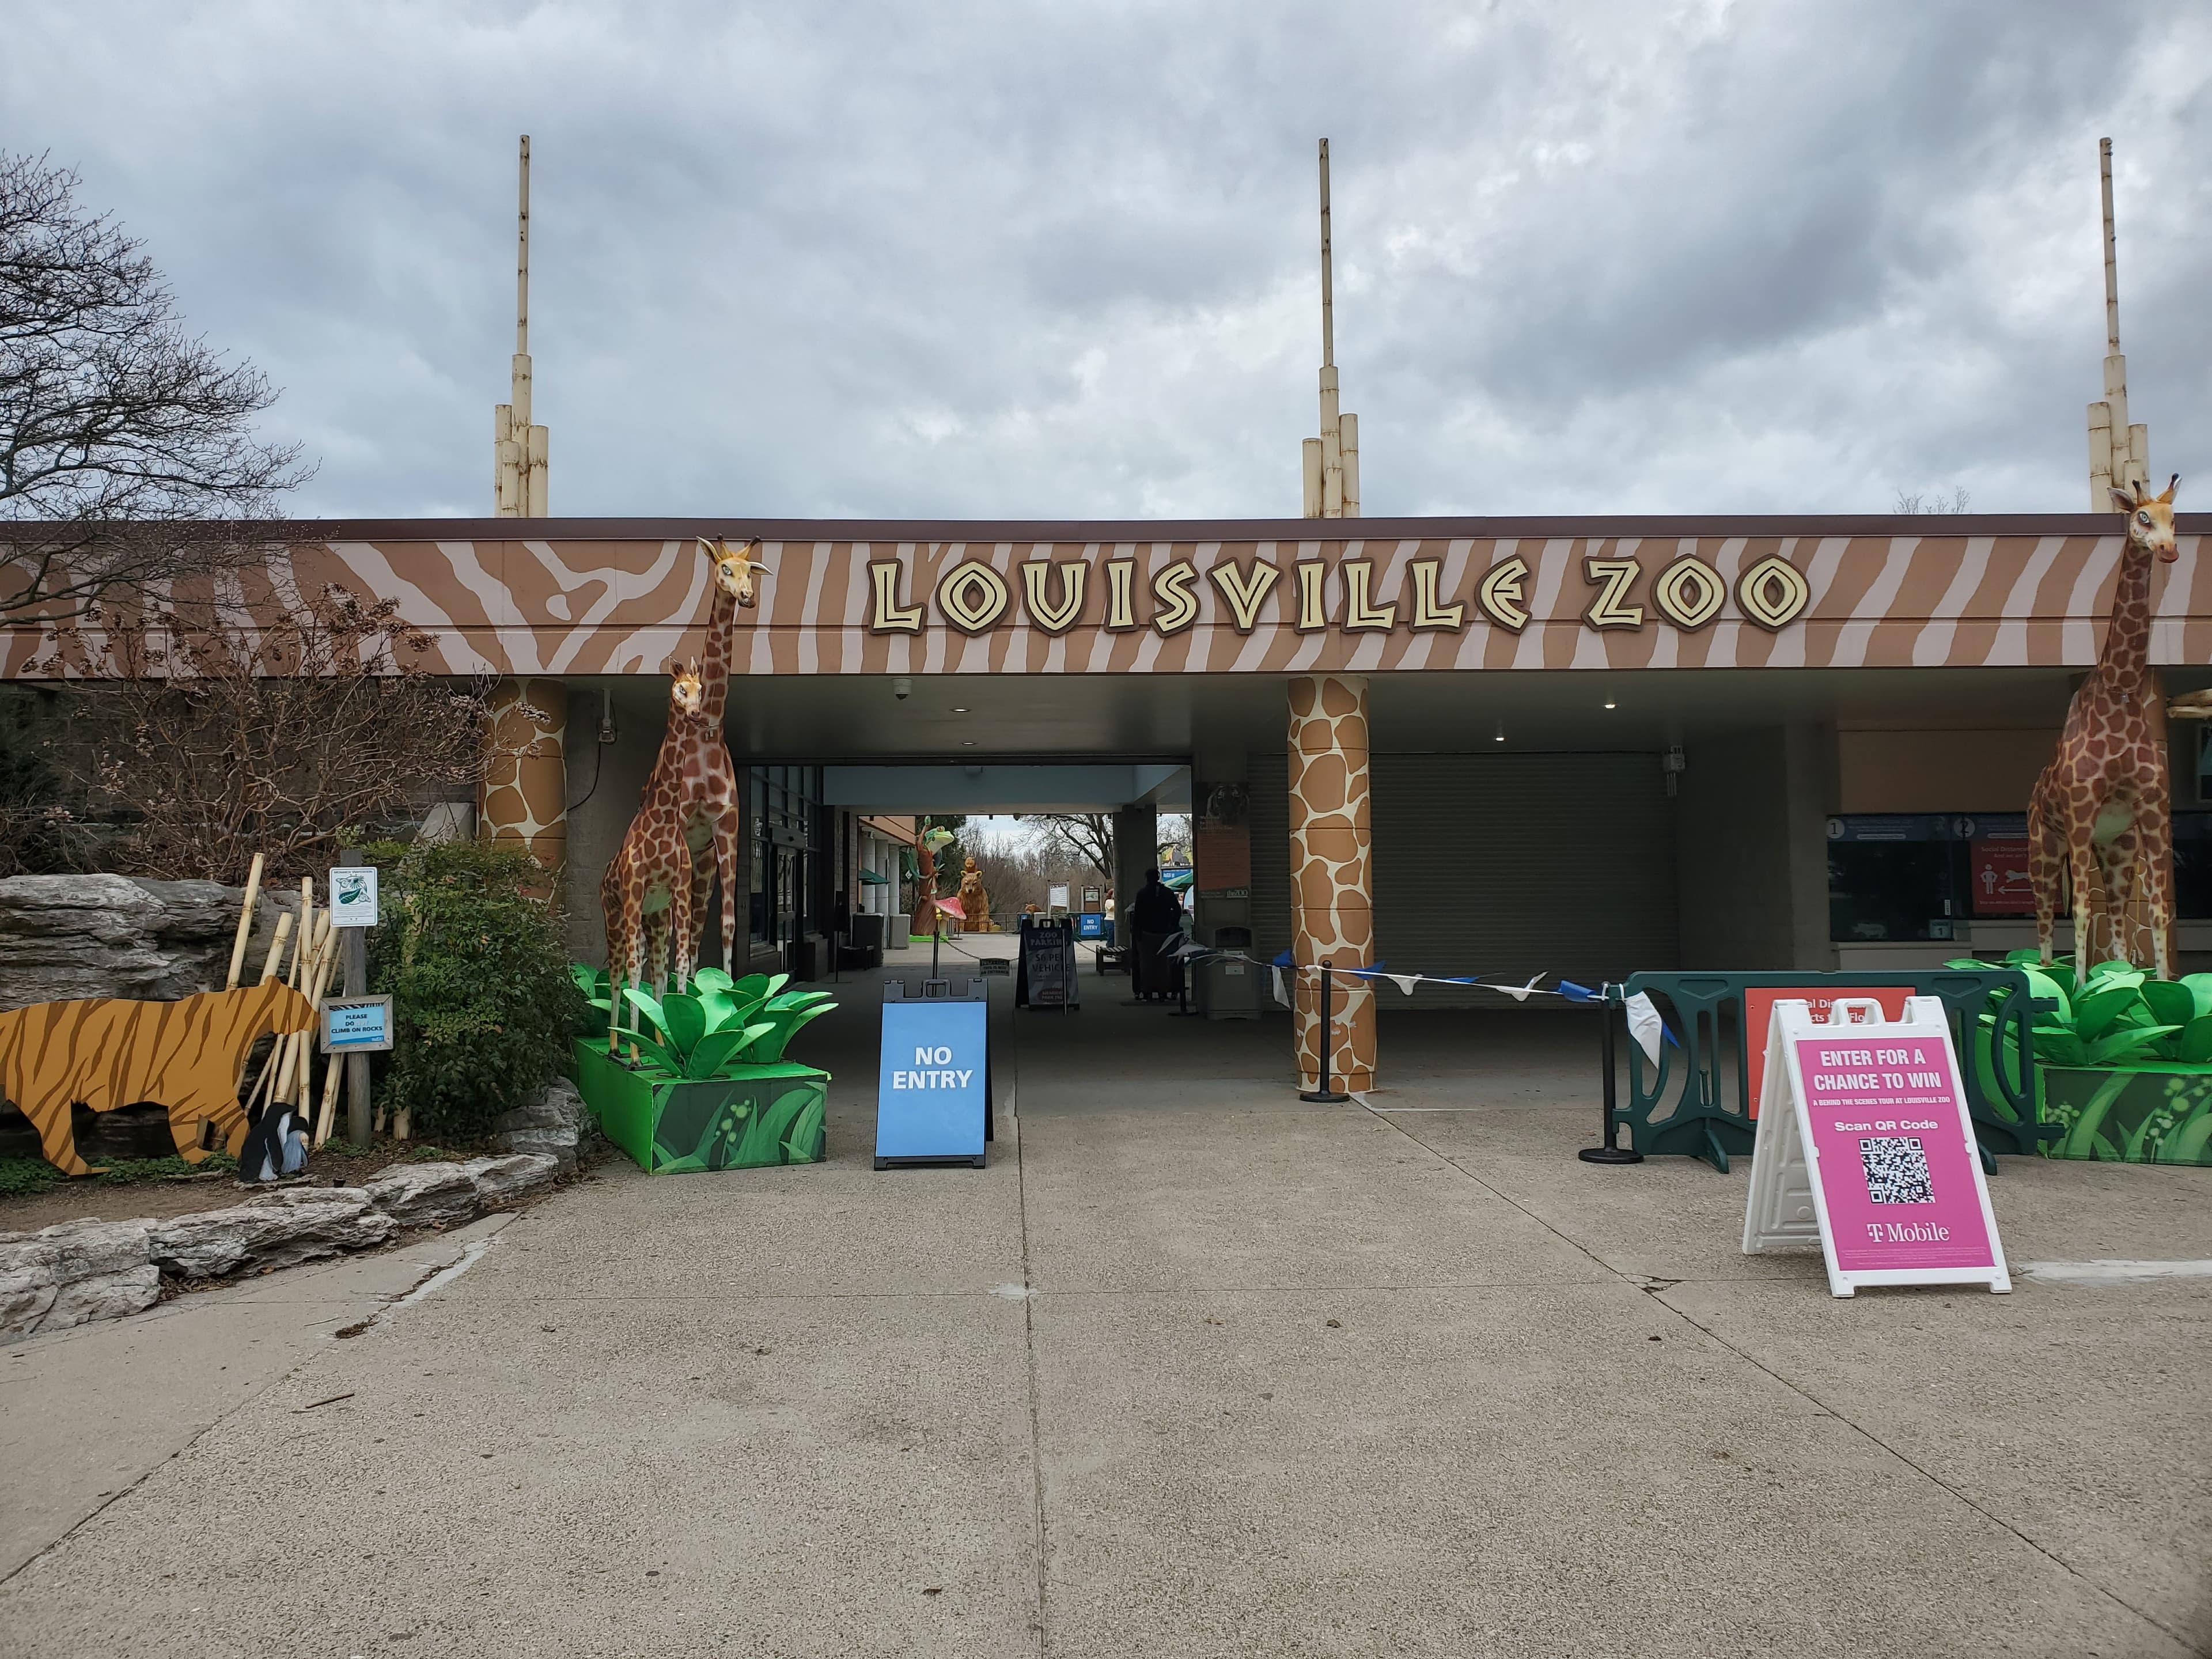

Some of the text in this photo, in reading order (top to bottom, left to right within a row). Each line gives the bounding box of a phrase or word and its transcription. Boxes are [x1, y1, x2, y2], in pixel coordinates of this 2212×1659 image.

[868, 552, 1812, 637] LOUISVILLE ZOO
[1830, 823, 1838, 834] 1
[1938, 927, 1942, 935] 1
[1032, 964, 1070, 972] VEHICE
[915, 1047, 952, 1065] NO
[1820, 1049, 1926, 1067] ENTER FOR A
[893, 1070, 972, 1089] ENTRY
[1814, 1072, 1942, 1090] CHANCE TO WIN
[1835, 1120, 1938, 1131] Scan QR Code
[1888, 1222, 1950, 1242] Mobile
